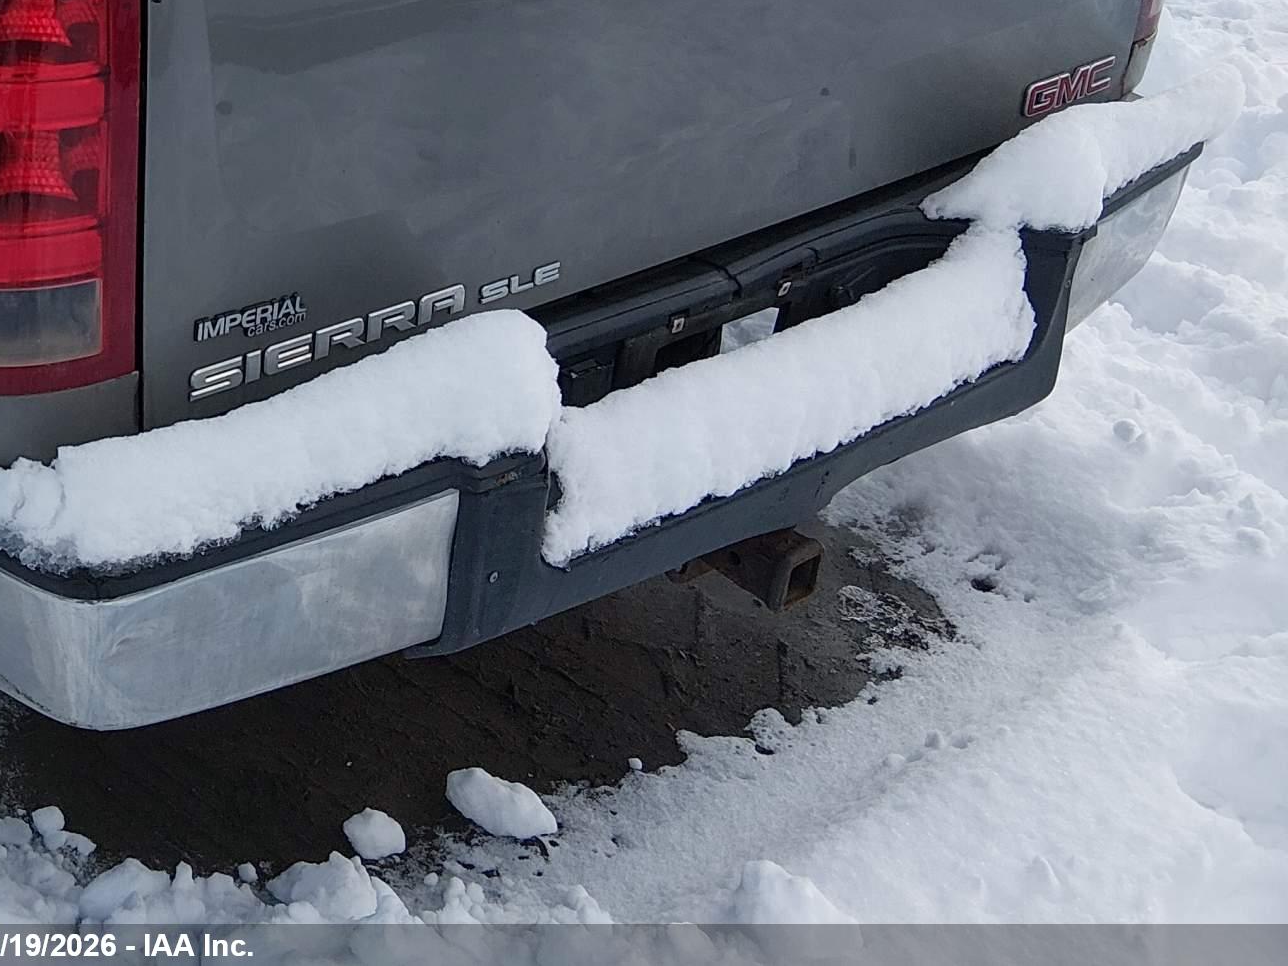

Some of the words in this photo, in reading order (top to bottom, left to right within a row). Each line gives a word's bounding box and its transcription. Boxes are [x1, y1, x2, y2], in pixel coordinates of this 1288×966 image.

[1024, 55, 1116, 118] GMC
[188, 283, 467, 402] SIERRA
[478, 260, 561, 305] SLE
[196, 295, 308, 342] IMPERIAL
[247, 312, 307, 338] cars.com
